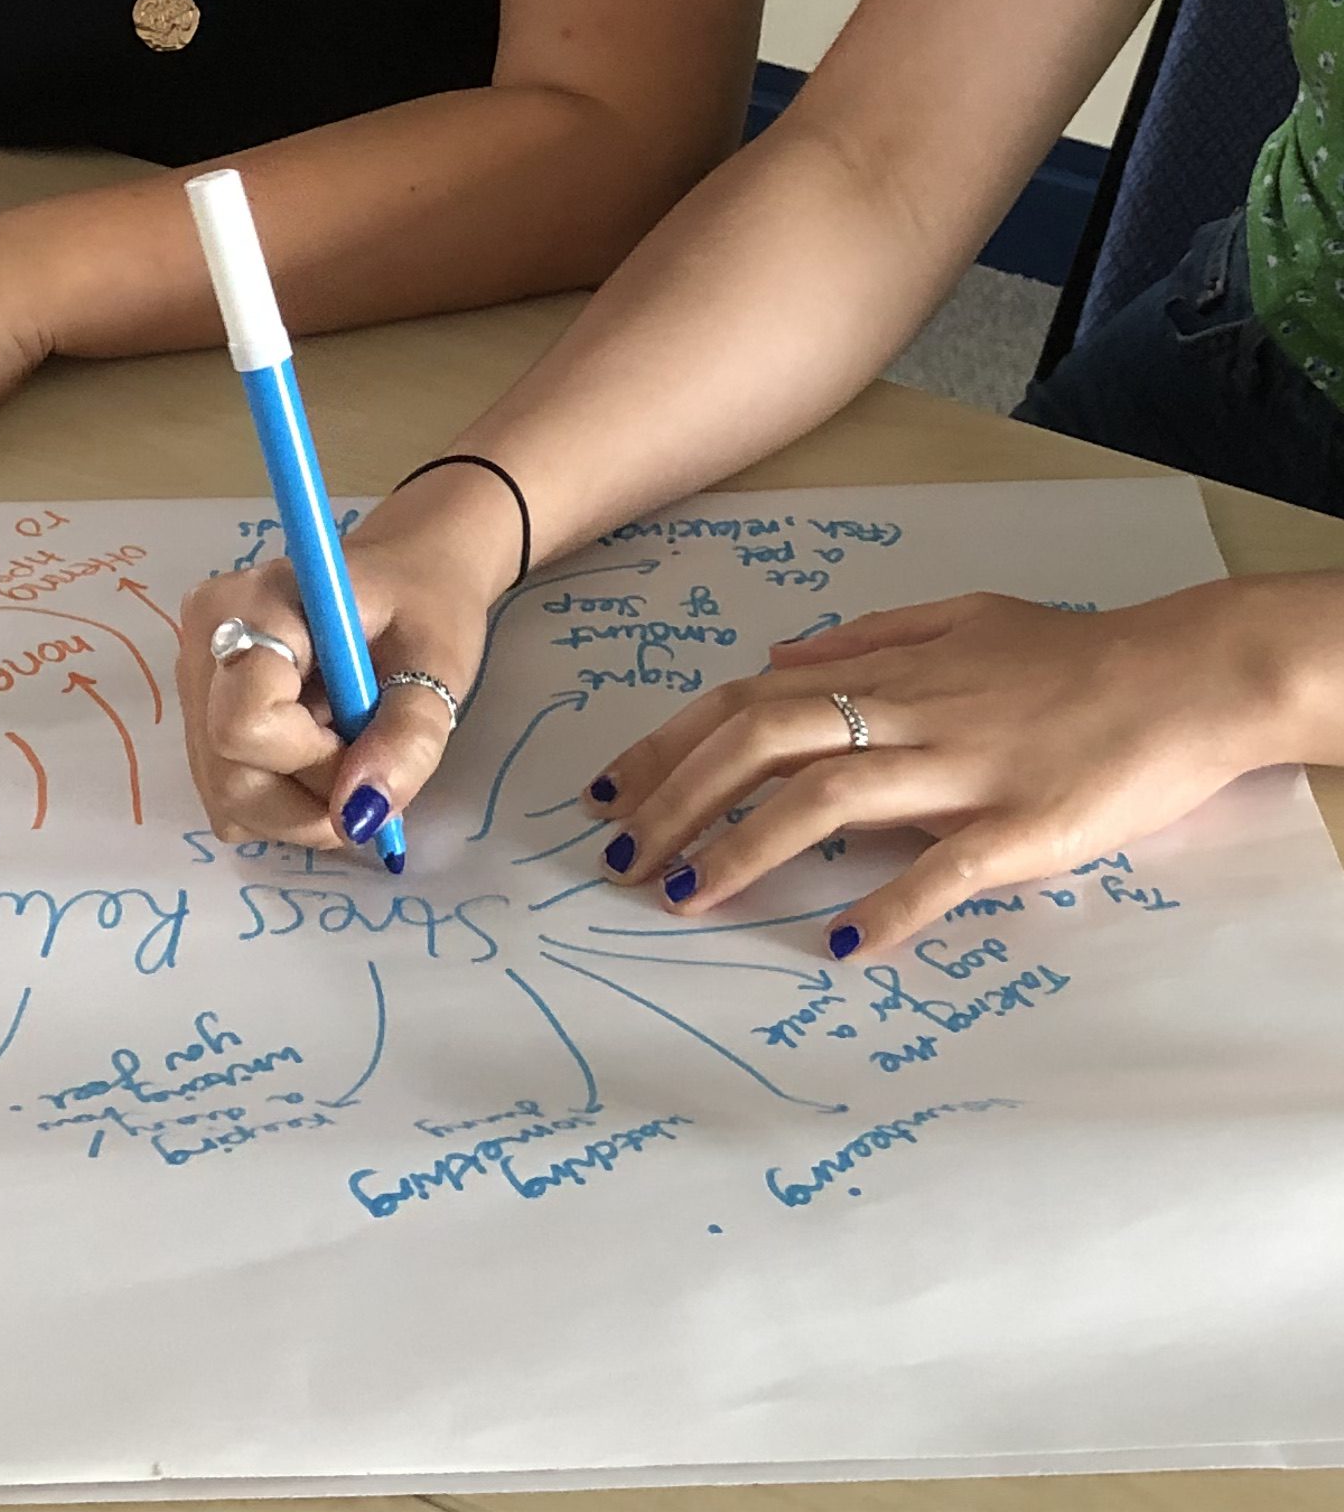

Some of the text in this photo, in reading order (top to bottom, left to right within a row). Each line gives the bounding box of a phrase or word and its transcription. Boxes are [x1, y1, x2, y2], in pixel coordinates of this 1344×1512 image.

[733, 540, 846, 567] a pet
[680, 586, 721, 618] of
[765, 570, 830, 592] Get
[550, 621, 737, 649] amount
[577, 641, 704, 691] Right
[1041, 888, 1076, 907] a
[1100, 875, 1181, 912] Try
[239, 883, 511, 965] Stress
[826, 938, 1008, 1039] dog for a
[751, 994, 847, 1049] walk
[869, 964, 1072, 1073] Taking the
[166, 1010, 243, 1072] you
[265, 1091, 305, 1105] a
[349, 1114, 598, 1218] something
